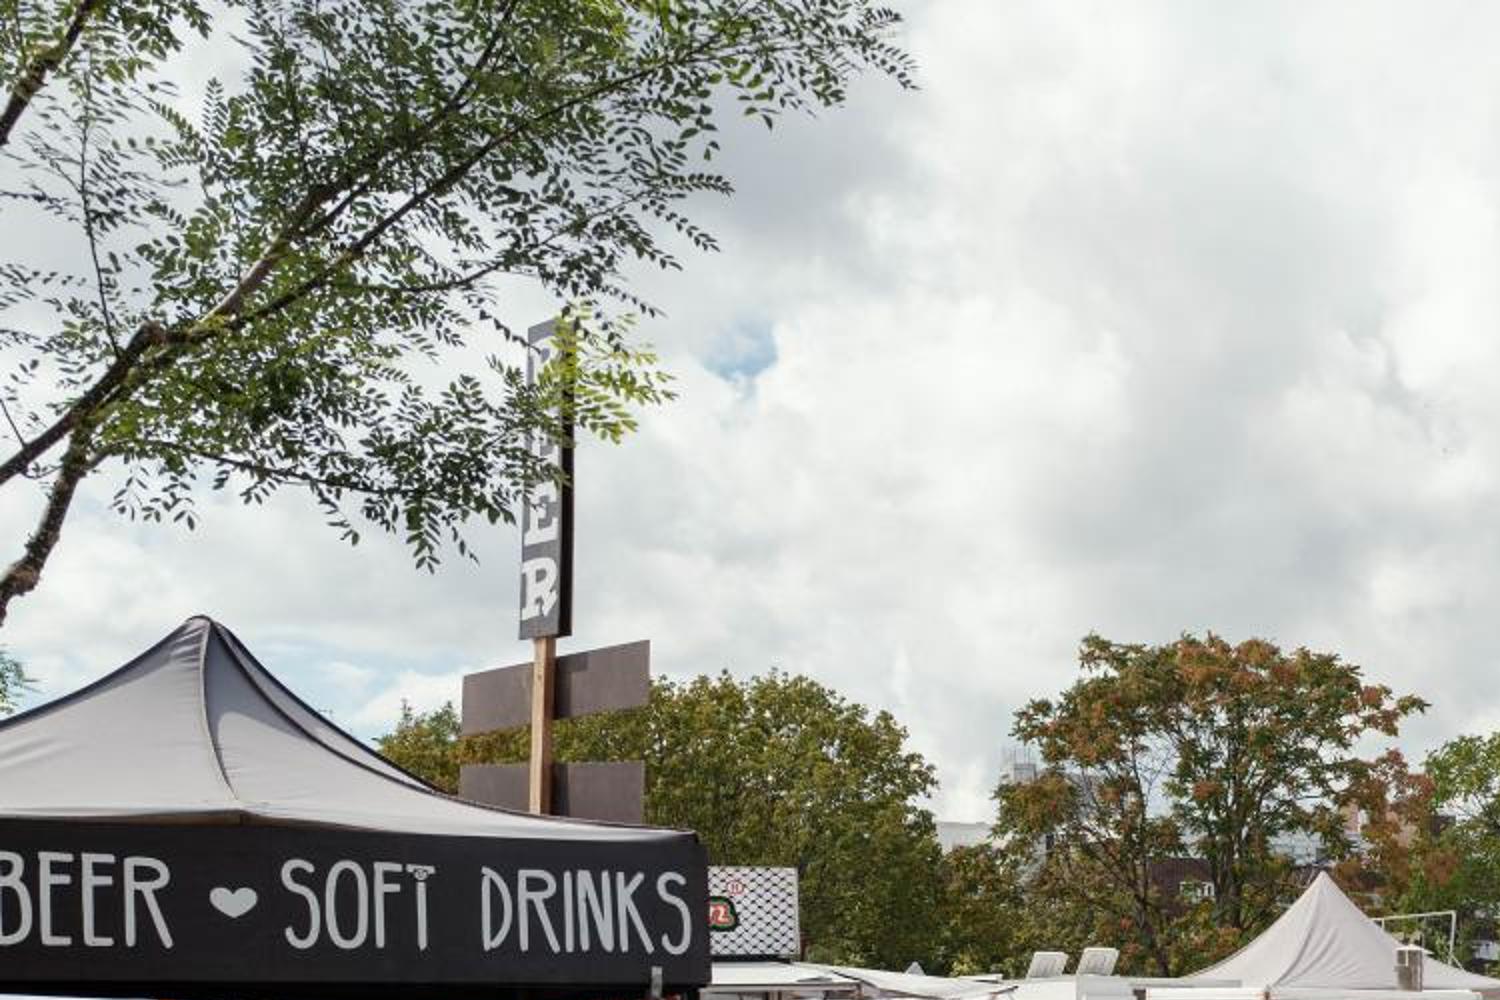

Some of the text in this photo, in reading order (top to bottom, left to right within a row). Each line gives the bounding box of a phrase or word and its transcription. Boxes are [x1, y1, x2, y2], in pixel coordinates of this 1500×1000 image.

[0, 851, 692, 955] BEER SOFT DRINKS
